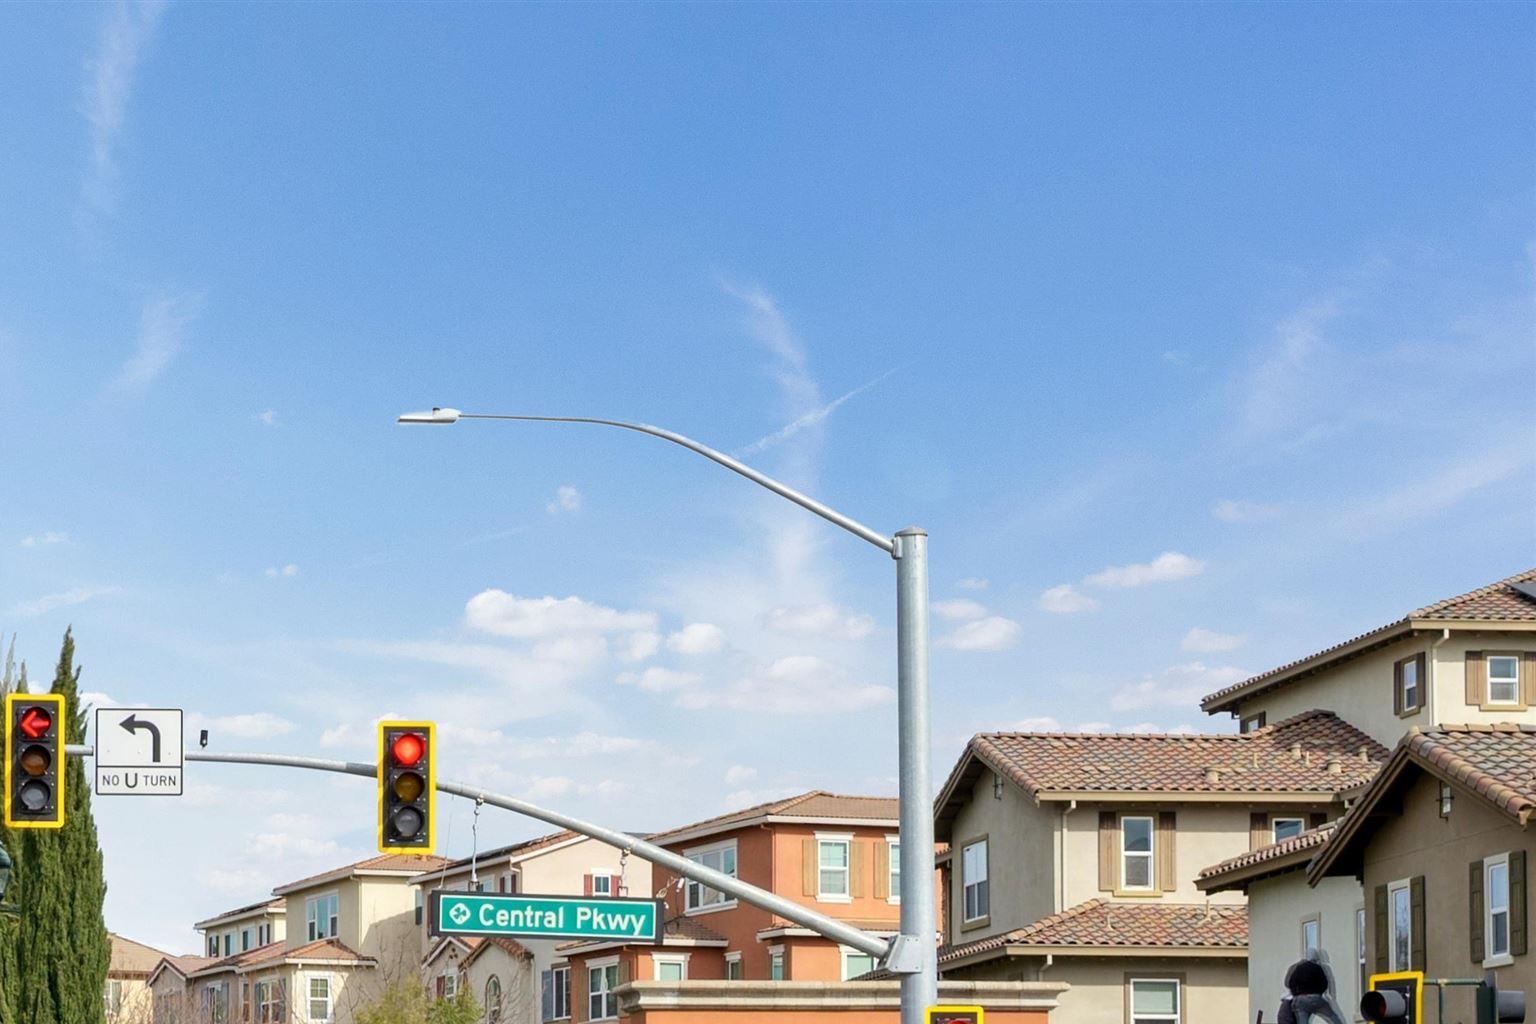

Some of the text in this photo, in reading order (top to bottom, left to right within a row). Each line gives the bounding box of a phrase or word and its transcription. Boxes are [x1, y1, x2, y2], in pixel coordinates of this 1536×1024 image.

[102, 772, 176, 788] NO U TURN
[478, 903, 645, 935] Central Pkwy
